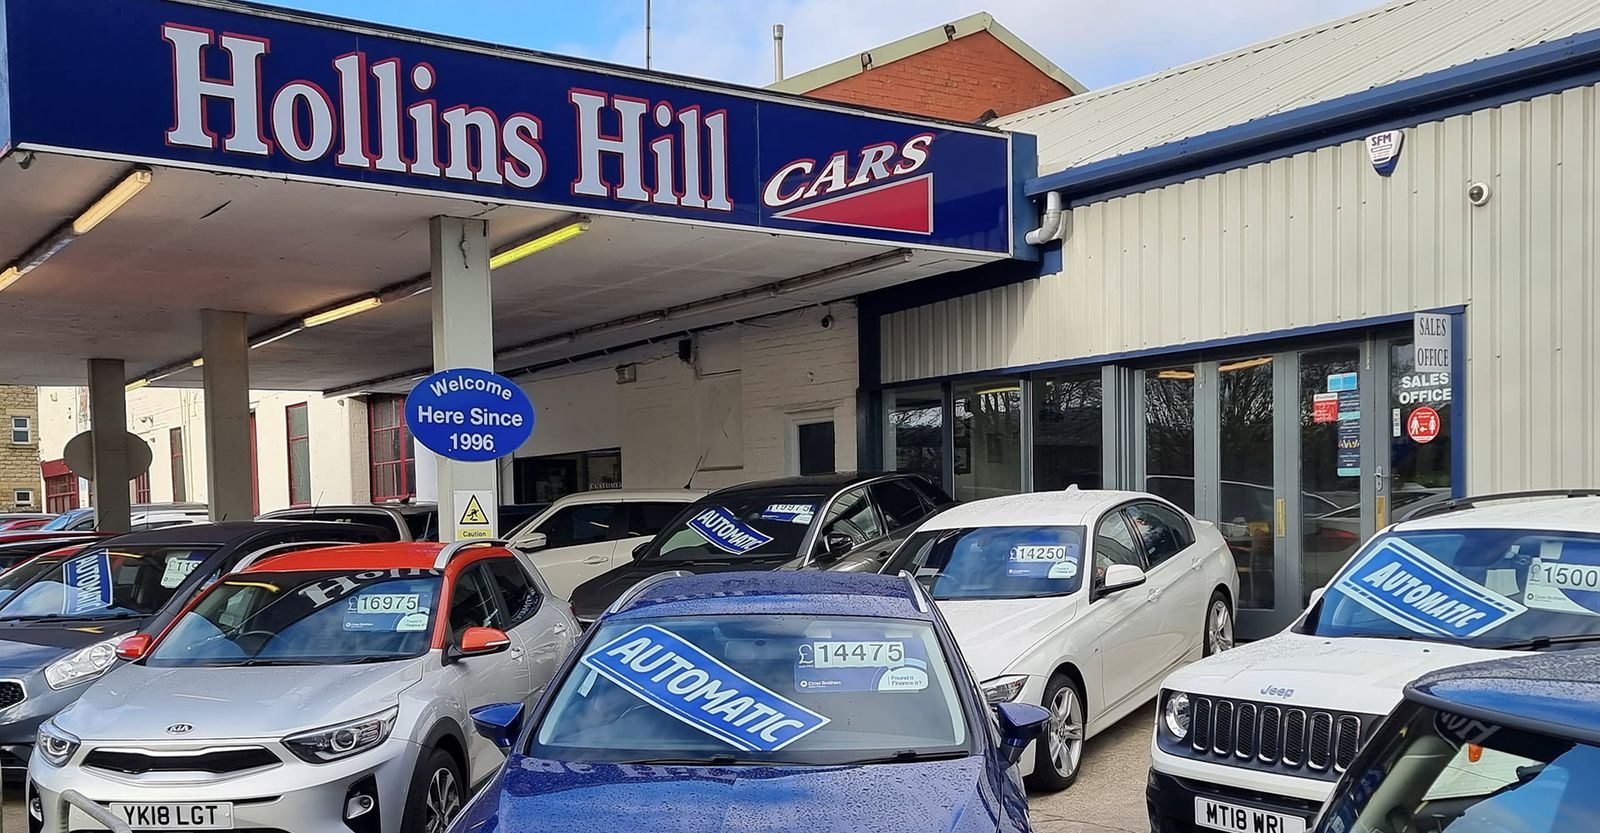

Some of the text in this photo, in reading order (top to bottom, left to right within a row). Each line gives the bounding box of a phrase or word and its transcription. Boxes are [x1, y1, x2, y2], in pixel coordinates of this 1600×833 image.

[161, 22, 734, 211] Hollins Hill
[1371, 133, 1391, 146] SFM
[763, 133, 936, 208] CARS
[1420, 317, 1446, 336] SALES
[1417, 348, 1448, 366] OFFICE
[429, 375, 513, 401] Welcome
[1401, 372, 1449, 389] SALES
[1399, 388, 1452, 404] OFFICE
[418, 406, 523, 427] Here Since
[450, 433, 494, 451] 1996
[463, 530, 486, 538] Caution
[347, 595, 417, 612] £16975
[1363, 562, 1487, 629] AUTOMATIC
[799, 643, 903, 664] £14475
[607, 636, 805, 742] AUTOMATIC
[1261, 684, 1294, 699] Jeep
[123, 806, 217, 825] YK18 LGT
[1206, 802, 1247, 831] MT18
